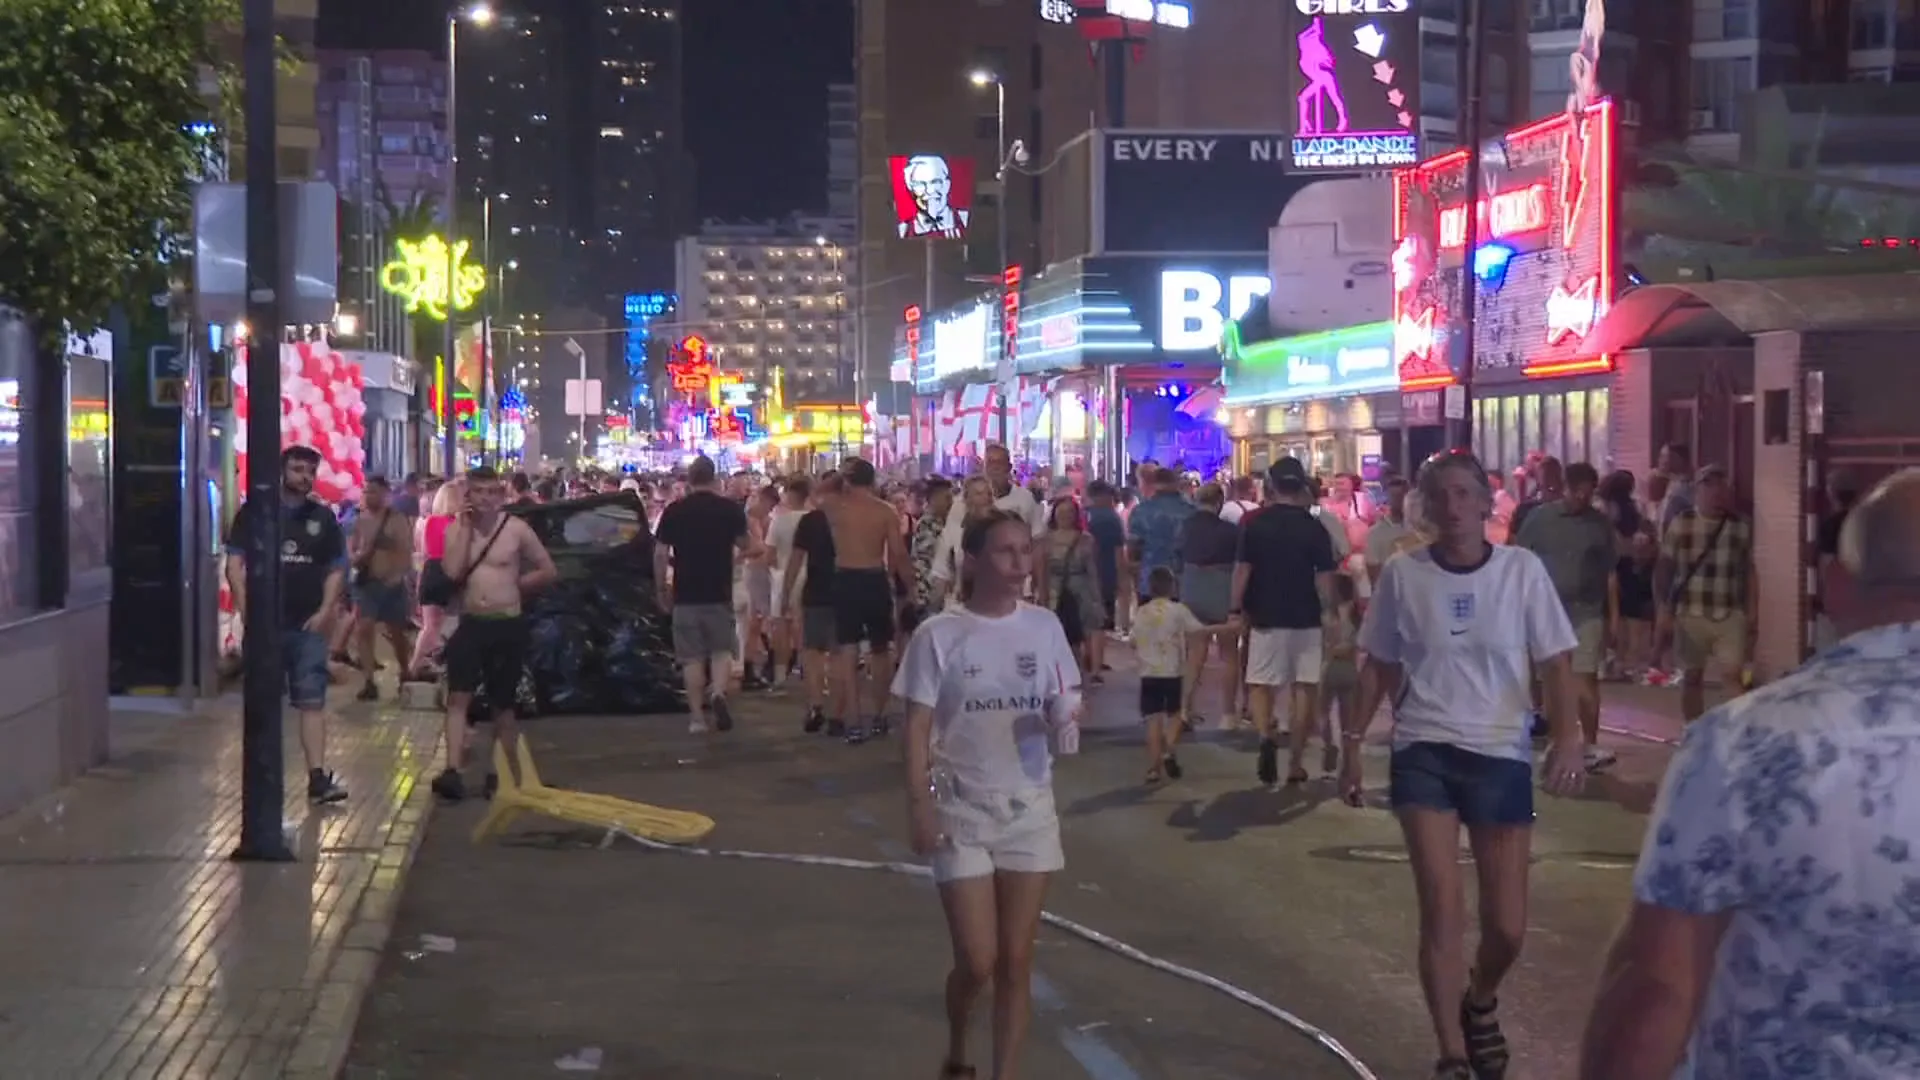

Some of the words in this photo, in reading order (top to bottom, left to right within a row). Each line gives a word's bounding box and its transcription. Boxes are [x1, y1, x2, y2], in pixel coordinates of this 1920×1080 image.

[1296, 0, 1408, 15] GIRLS
[1113, 139, 1217, 161] EVERY
[1292, 135, 1417, 154] LAP-DANCE
[965, 696, 1042, 713] ENGLAND
